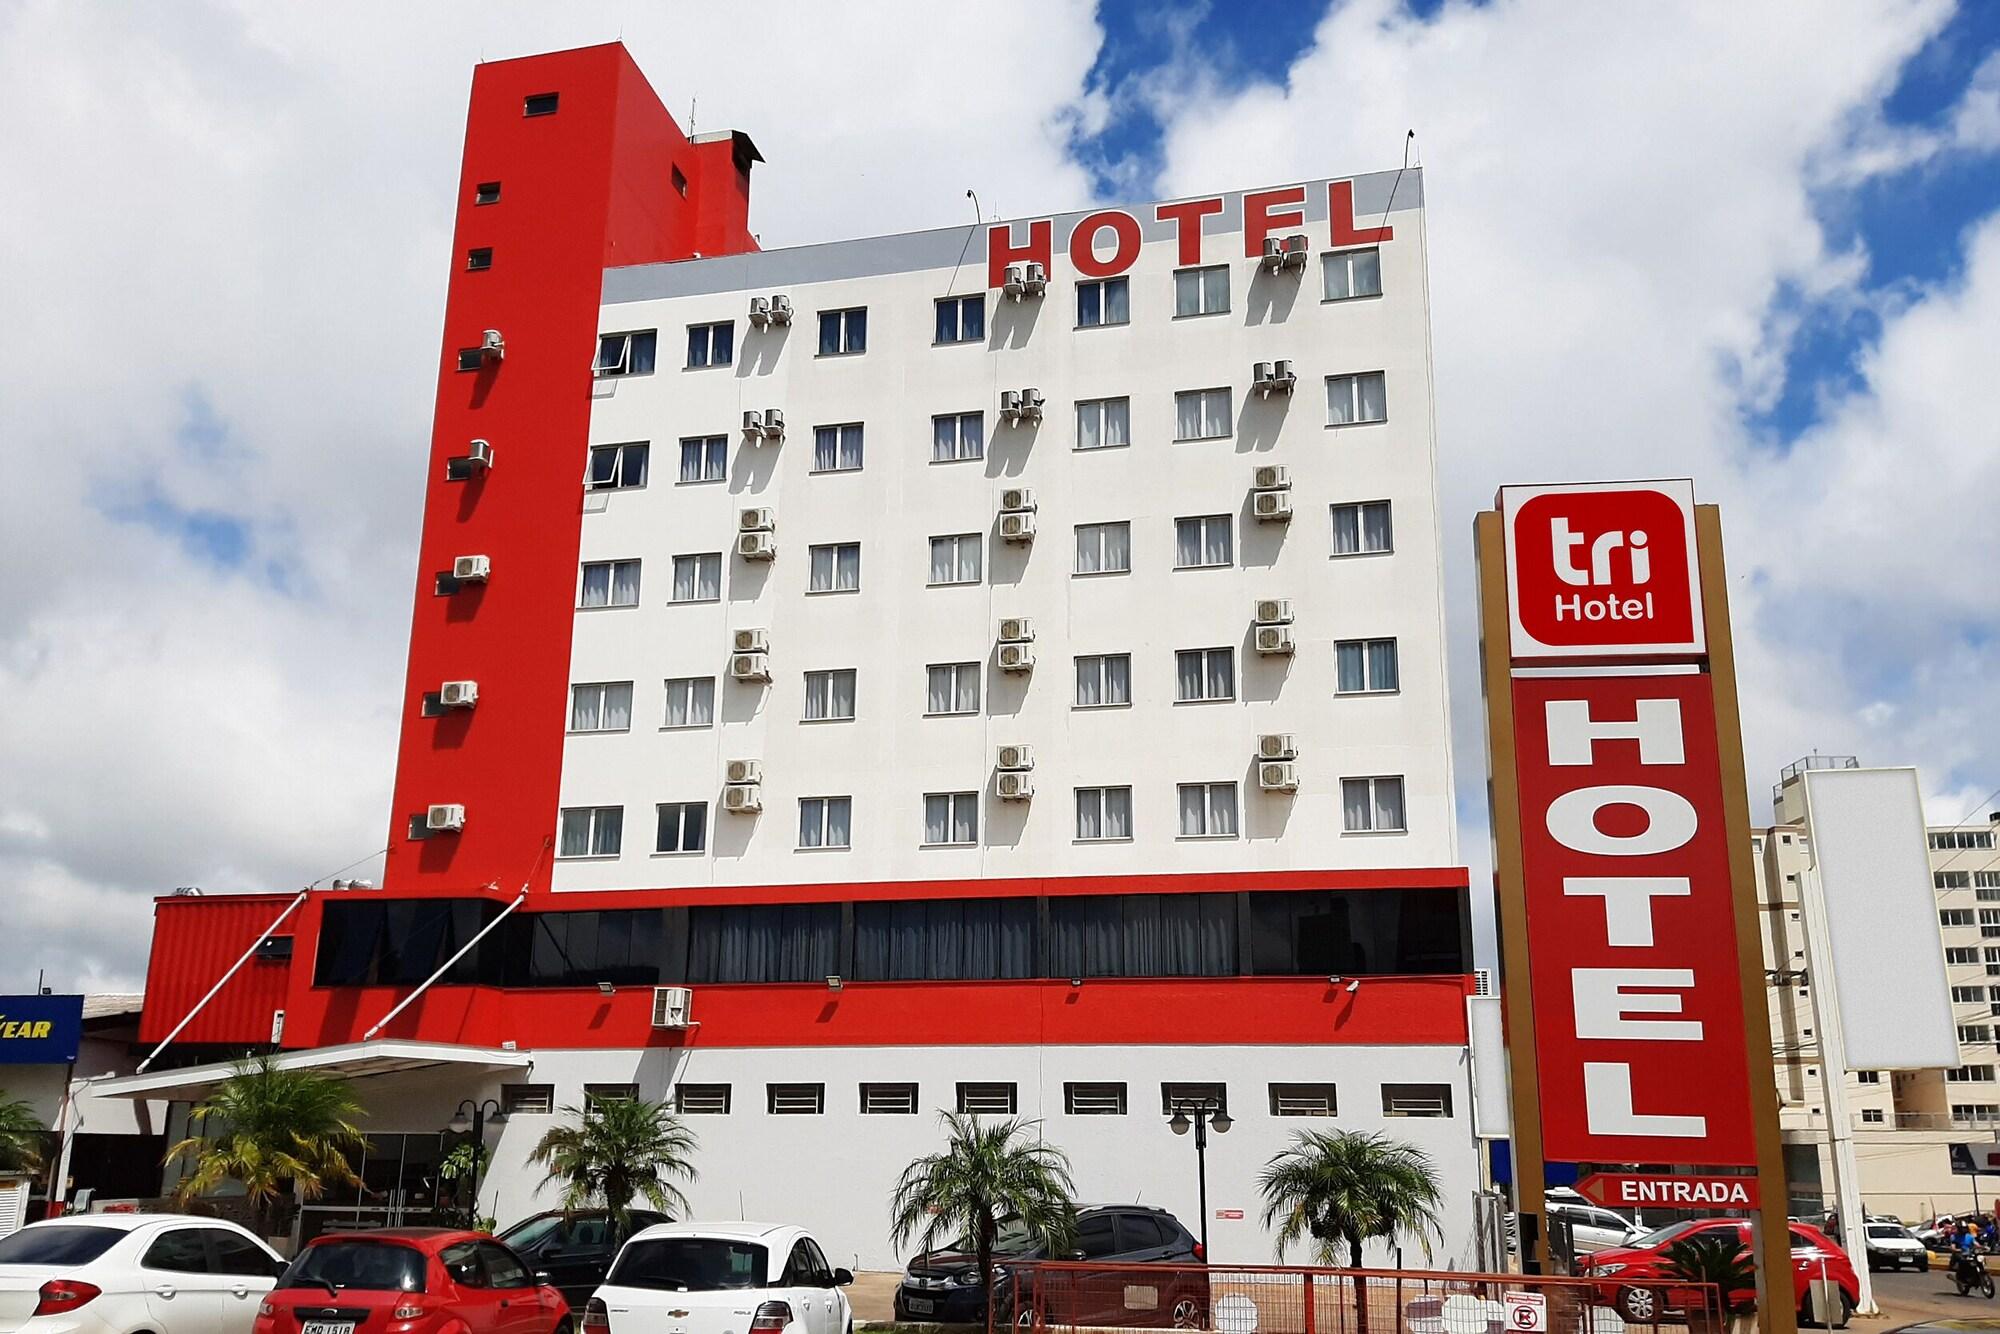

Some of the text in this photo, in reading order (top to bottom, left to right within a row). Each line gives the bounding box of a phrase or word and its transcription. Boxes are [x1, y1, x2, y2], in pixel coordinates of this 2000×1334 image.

[988, 178, 1394, 290] HOTEL
[1550, 517, 1651, 586] tri
[1555, 591, 1654, 622] Hotel
[1544, 698, 1707, 1138] HOTEL
[1621, 1180, 1749, 1203] ENTRADA
